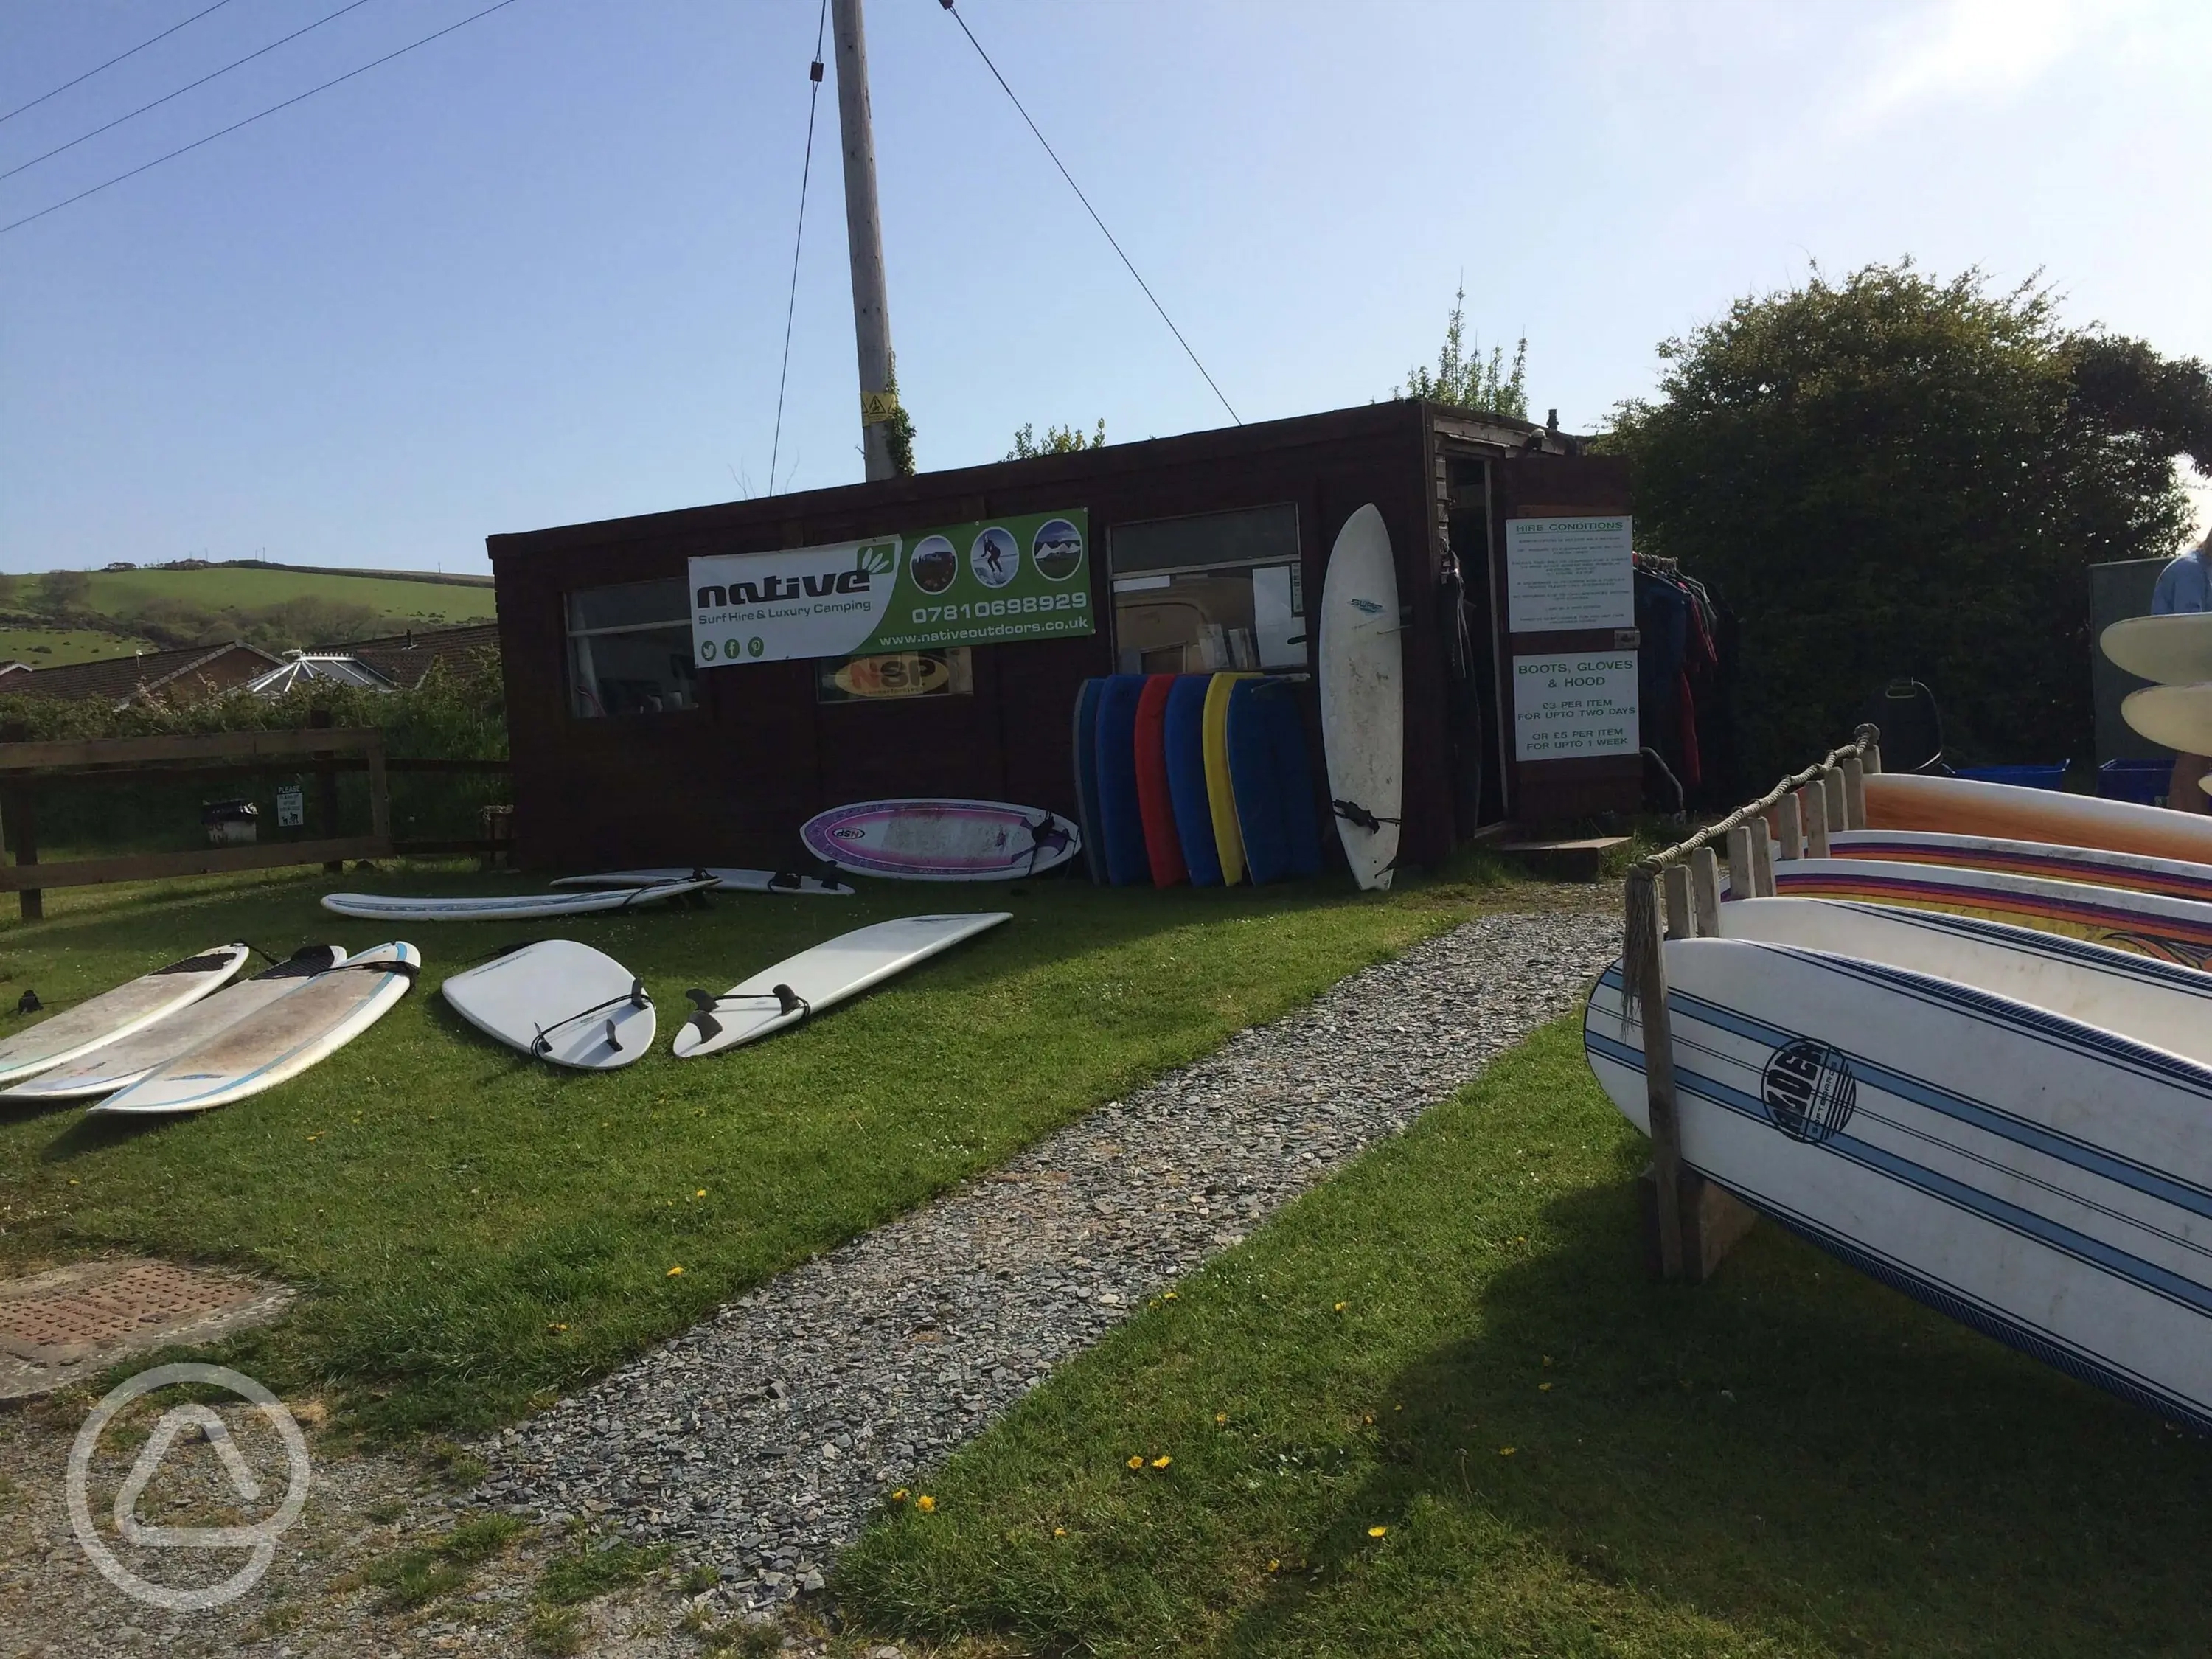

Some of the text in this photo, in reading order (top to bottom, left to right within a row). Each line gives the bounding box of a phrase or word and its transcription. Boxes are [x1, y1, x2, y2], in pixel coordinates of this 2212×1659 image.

[1516, 521, 1623, 532] HIRE CONDITIONS
[698, 569, 870, 608] native
[699, 600, 871, 625] Surf Hire & Luxury Camping
[912, 591, 1087, 624] 07810698929
[879, 616, 1089, 647] www.nativeoutdoors.co.uk
[850, 658, 936, 689] NSP
[1518, 660, 1633, 675] BOOTS, GLOVES
[1548, 677, 1606, 688] & HOOD
[1561, 700, 1582, 709] PER
[1587, 699, 1613, 707] ITEM
[1518, 706, 1636, 720] FOR UPTO TWO DAYS
[1598, 728, 1624, 737] ITEM
[1527, 742, 1549, 751] FOR
[1554, 740, 1583, 748] UPTO
[1597, 738, 1627, 746] WEEK
[278, 785, 302, 794] PLEASE
[836, 830, 859, 838] NSP
[1811, 1060, 1838, 1134] SOFTBOARDS
